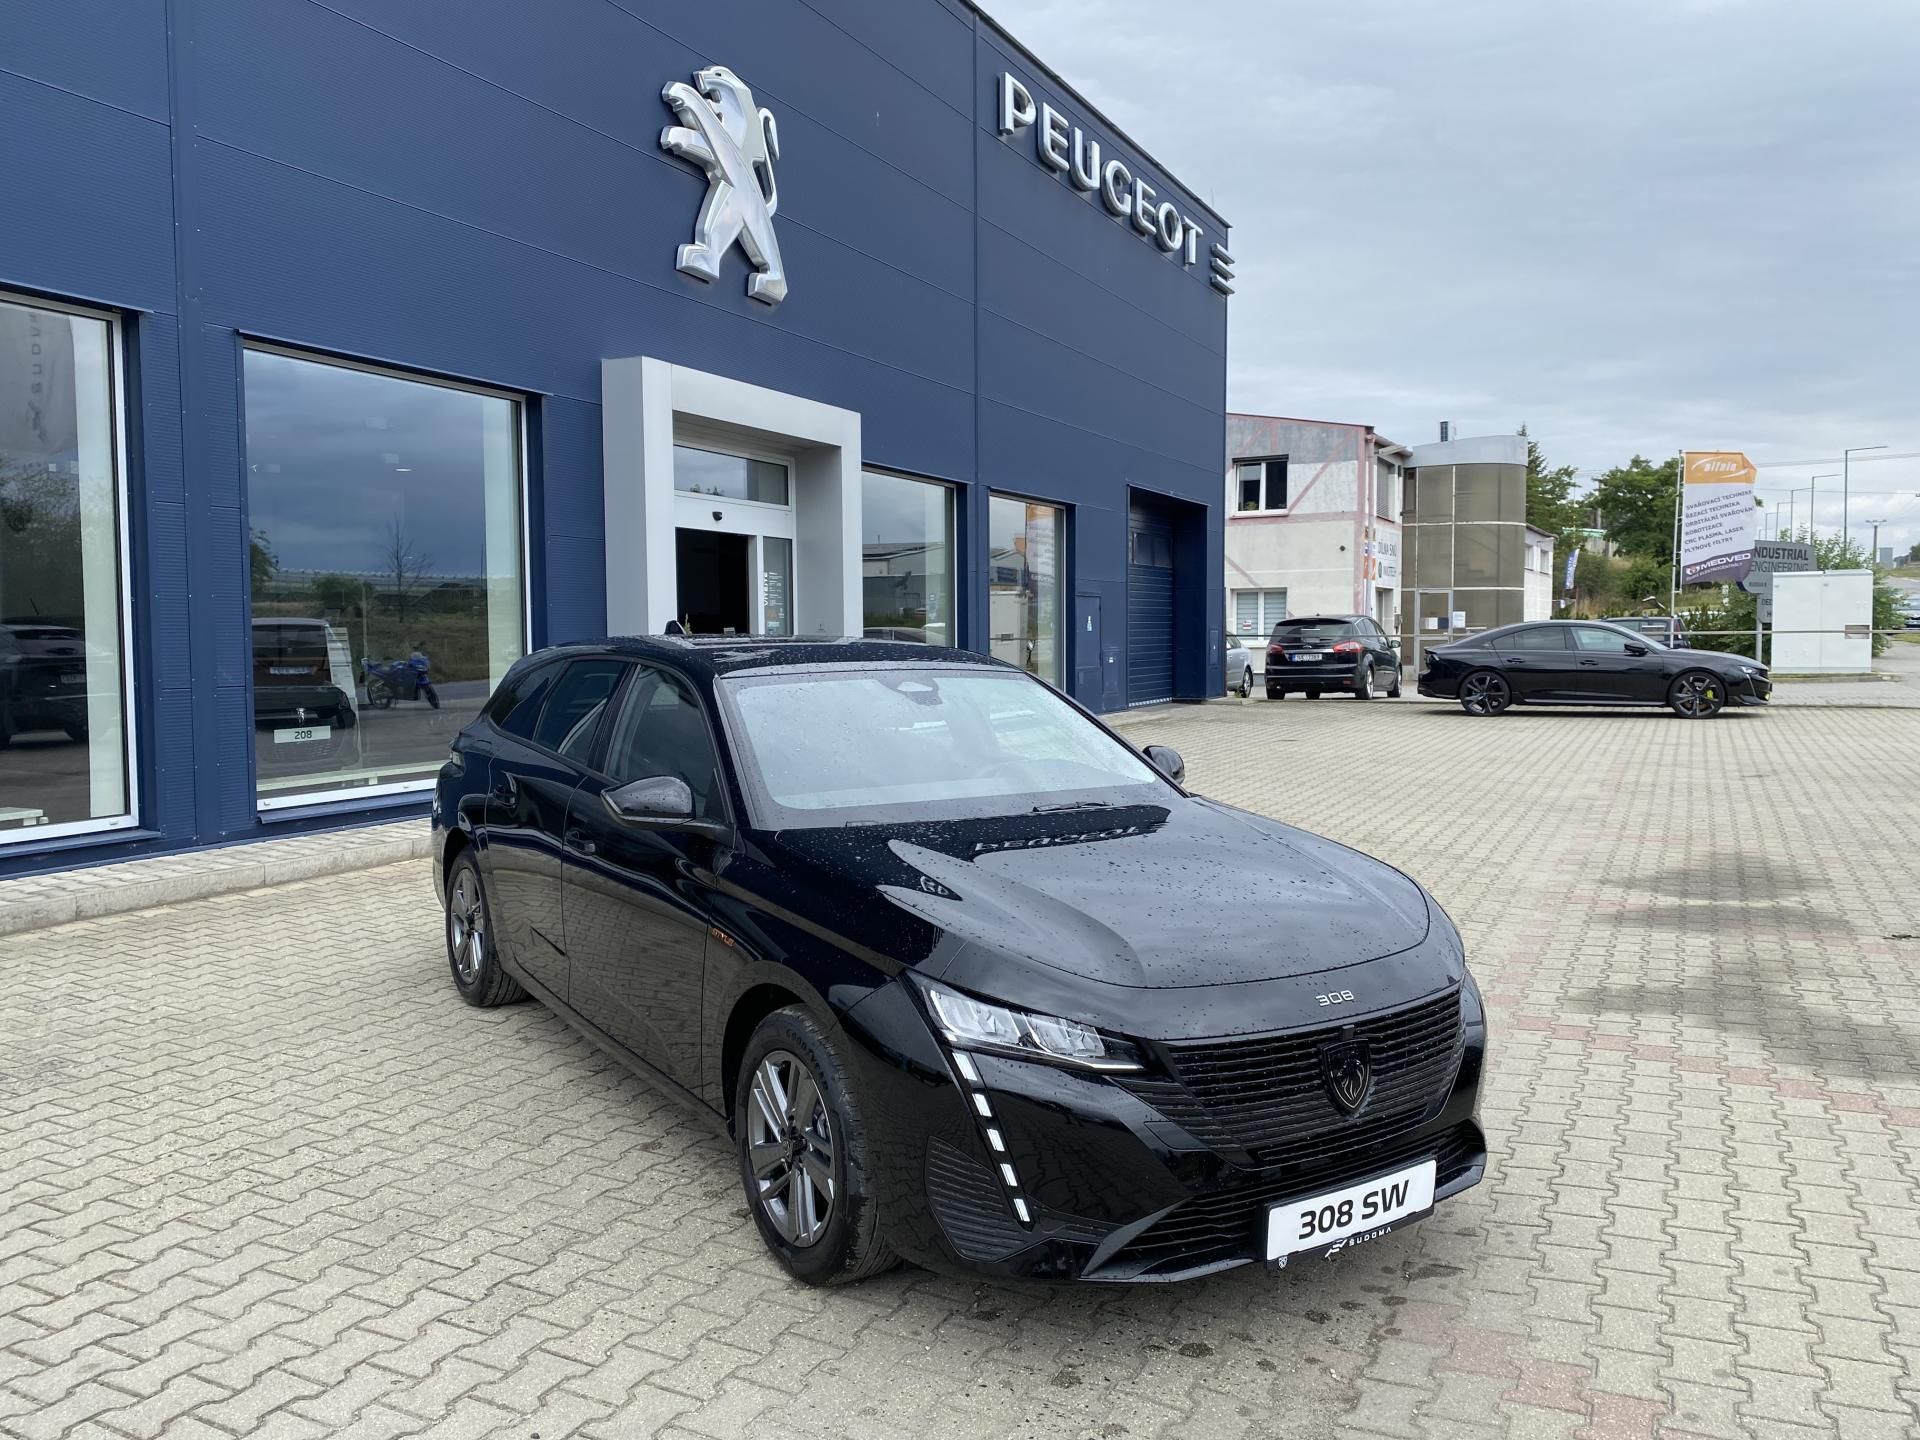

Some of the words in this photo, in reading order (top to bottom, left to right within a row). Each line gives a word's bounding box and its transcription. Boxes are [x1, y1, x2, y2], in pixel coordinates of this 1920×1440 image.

[998, 71, 1203, 266] PEUGEOT
[1709, 501, 1741, 512] TECHNIKA
[1720, 506, 1754, 519] SVAŘOVÁN
[1685, 522, 1723, 536] ROBOTIZACE
[1685, 537, 1697, 545] CNC
[1724, 526, 1744, 534] LASER
[1700, 553, 1751, 570] MEDVED
[1753, 546, 1809, 561] NDUSTRIAL
[294, 730, 312, 740] 208
[1315, 990, 1354, 1007] 308
[1299, 1200, 1354, 1241] 308
[1361, 1179, 1410, 1221] SW
